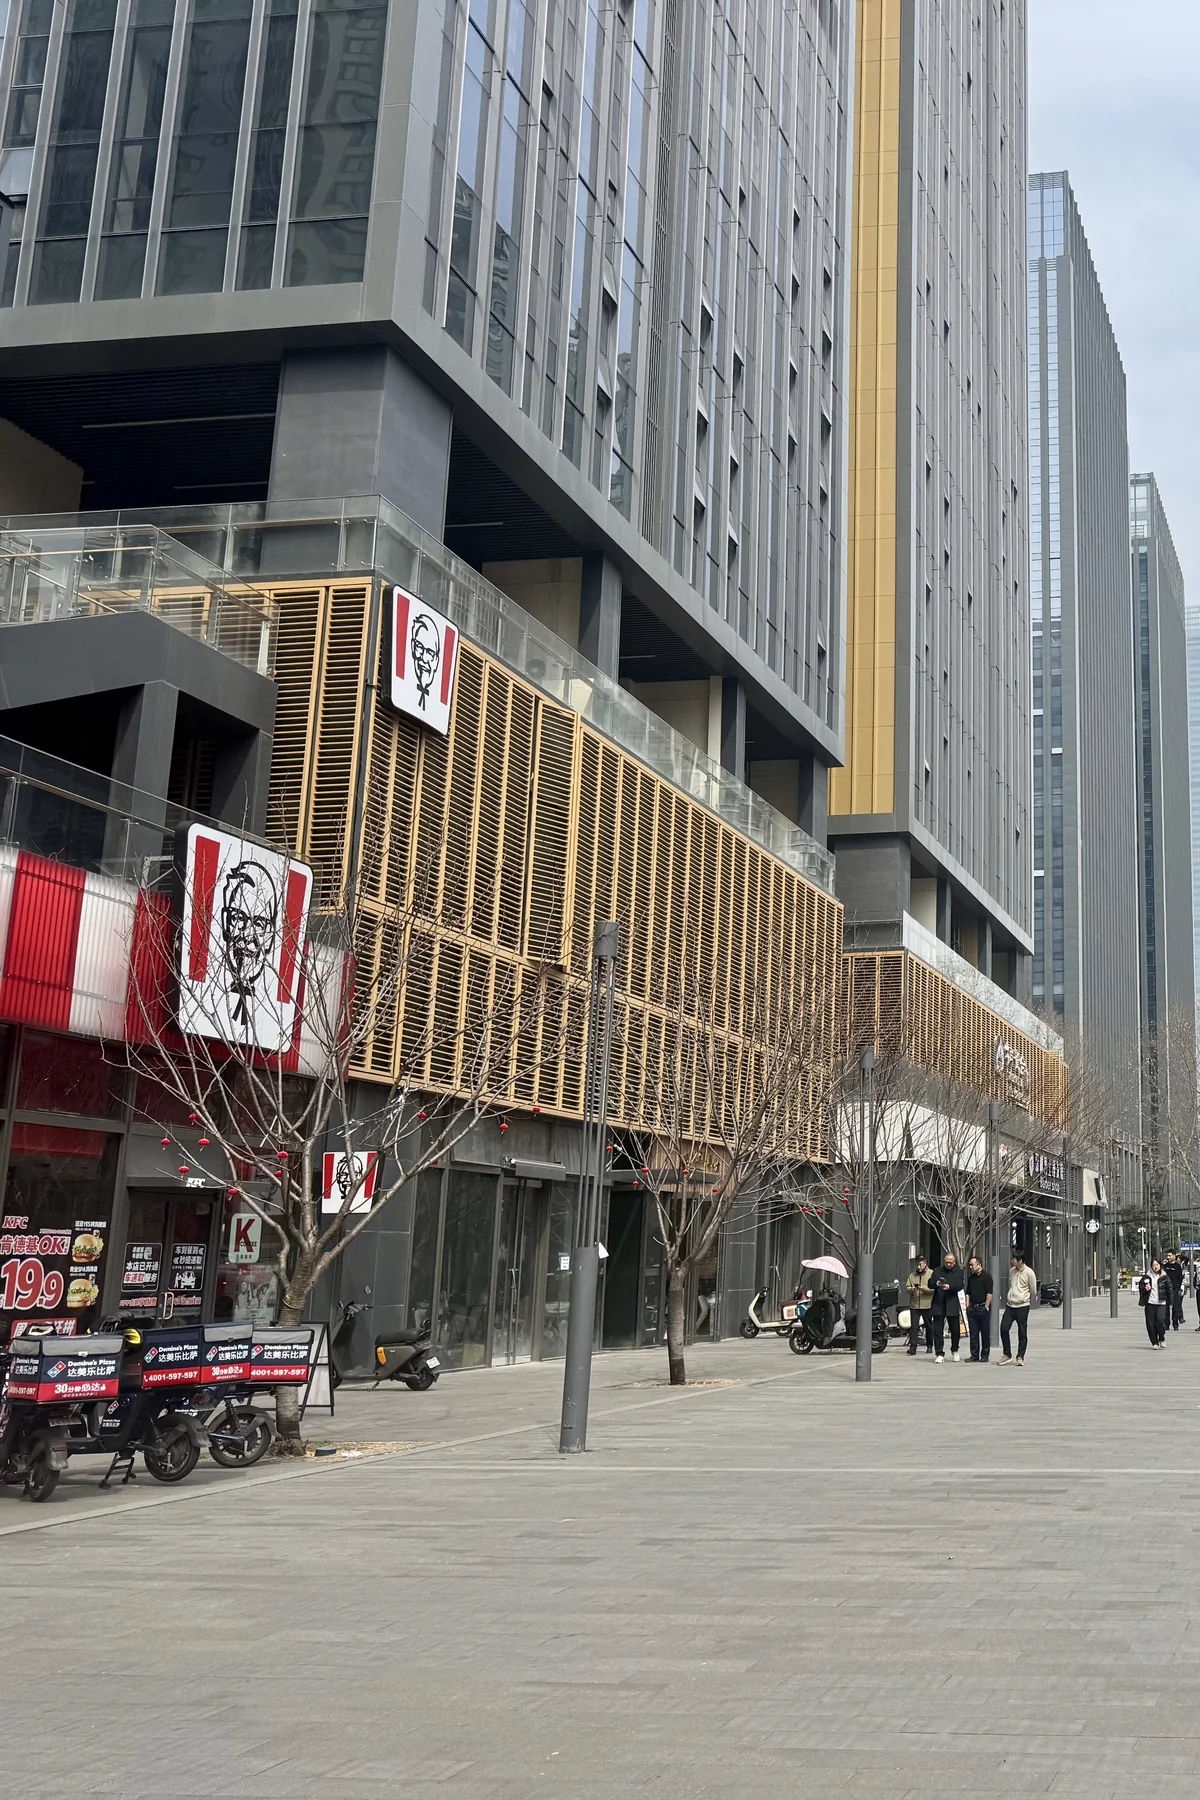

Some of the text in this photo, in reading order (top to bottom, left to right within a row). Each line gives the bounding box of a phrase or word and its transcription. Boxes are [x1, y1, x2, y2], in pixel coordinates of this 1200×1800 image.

[186, 1178, 206, 1188] KFC
[2, 1216, 28, 1229] KFC
[234, 1218, 255, 1252] K
[126, 1262, 159, 1272] 本店已开通
[1, 1257, 64, 1310] 19.9
[158, 1351, 198, 1362] 达美乐比萨
[218, 1351, 249, 1361] 达美乐比萨
[263, 1350, 308, 1360] 达美乐比萨
[67, 1366, 116, 1377] 达美乐比萨
[148, 1371, 198, 1382] 4001-597-597
[250, 1369, 306, 1377] 4001-597-597
